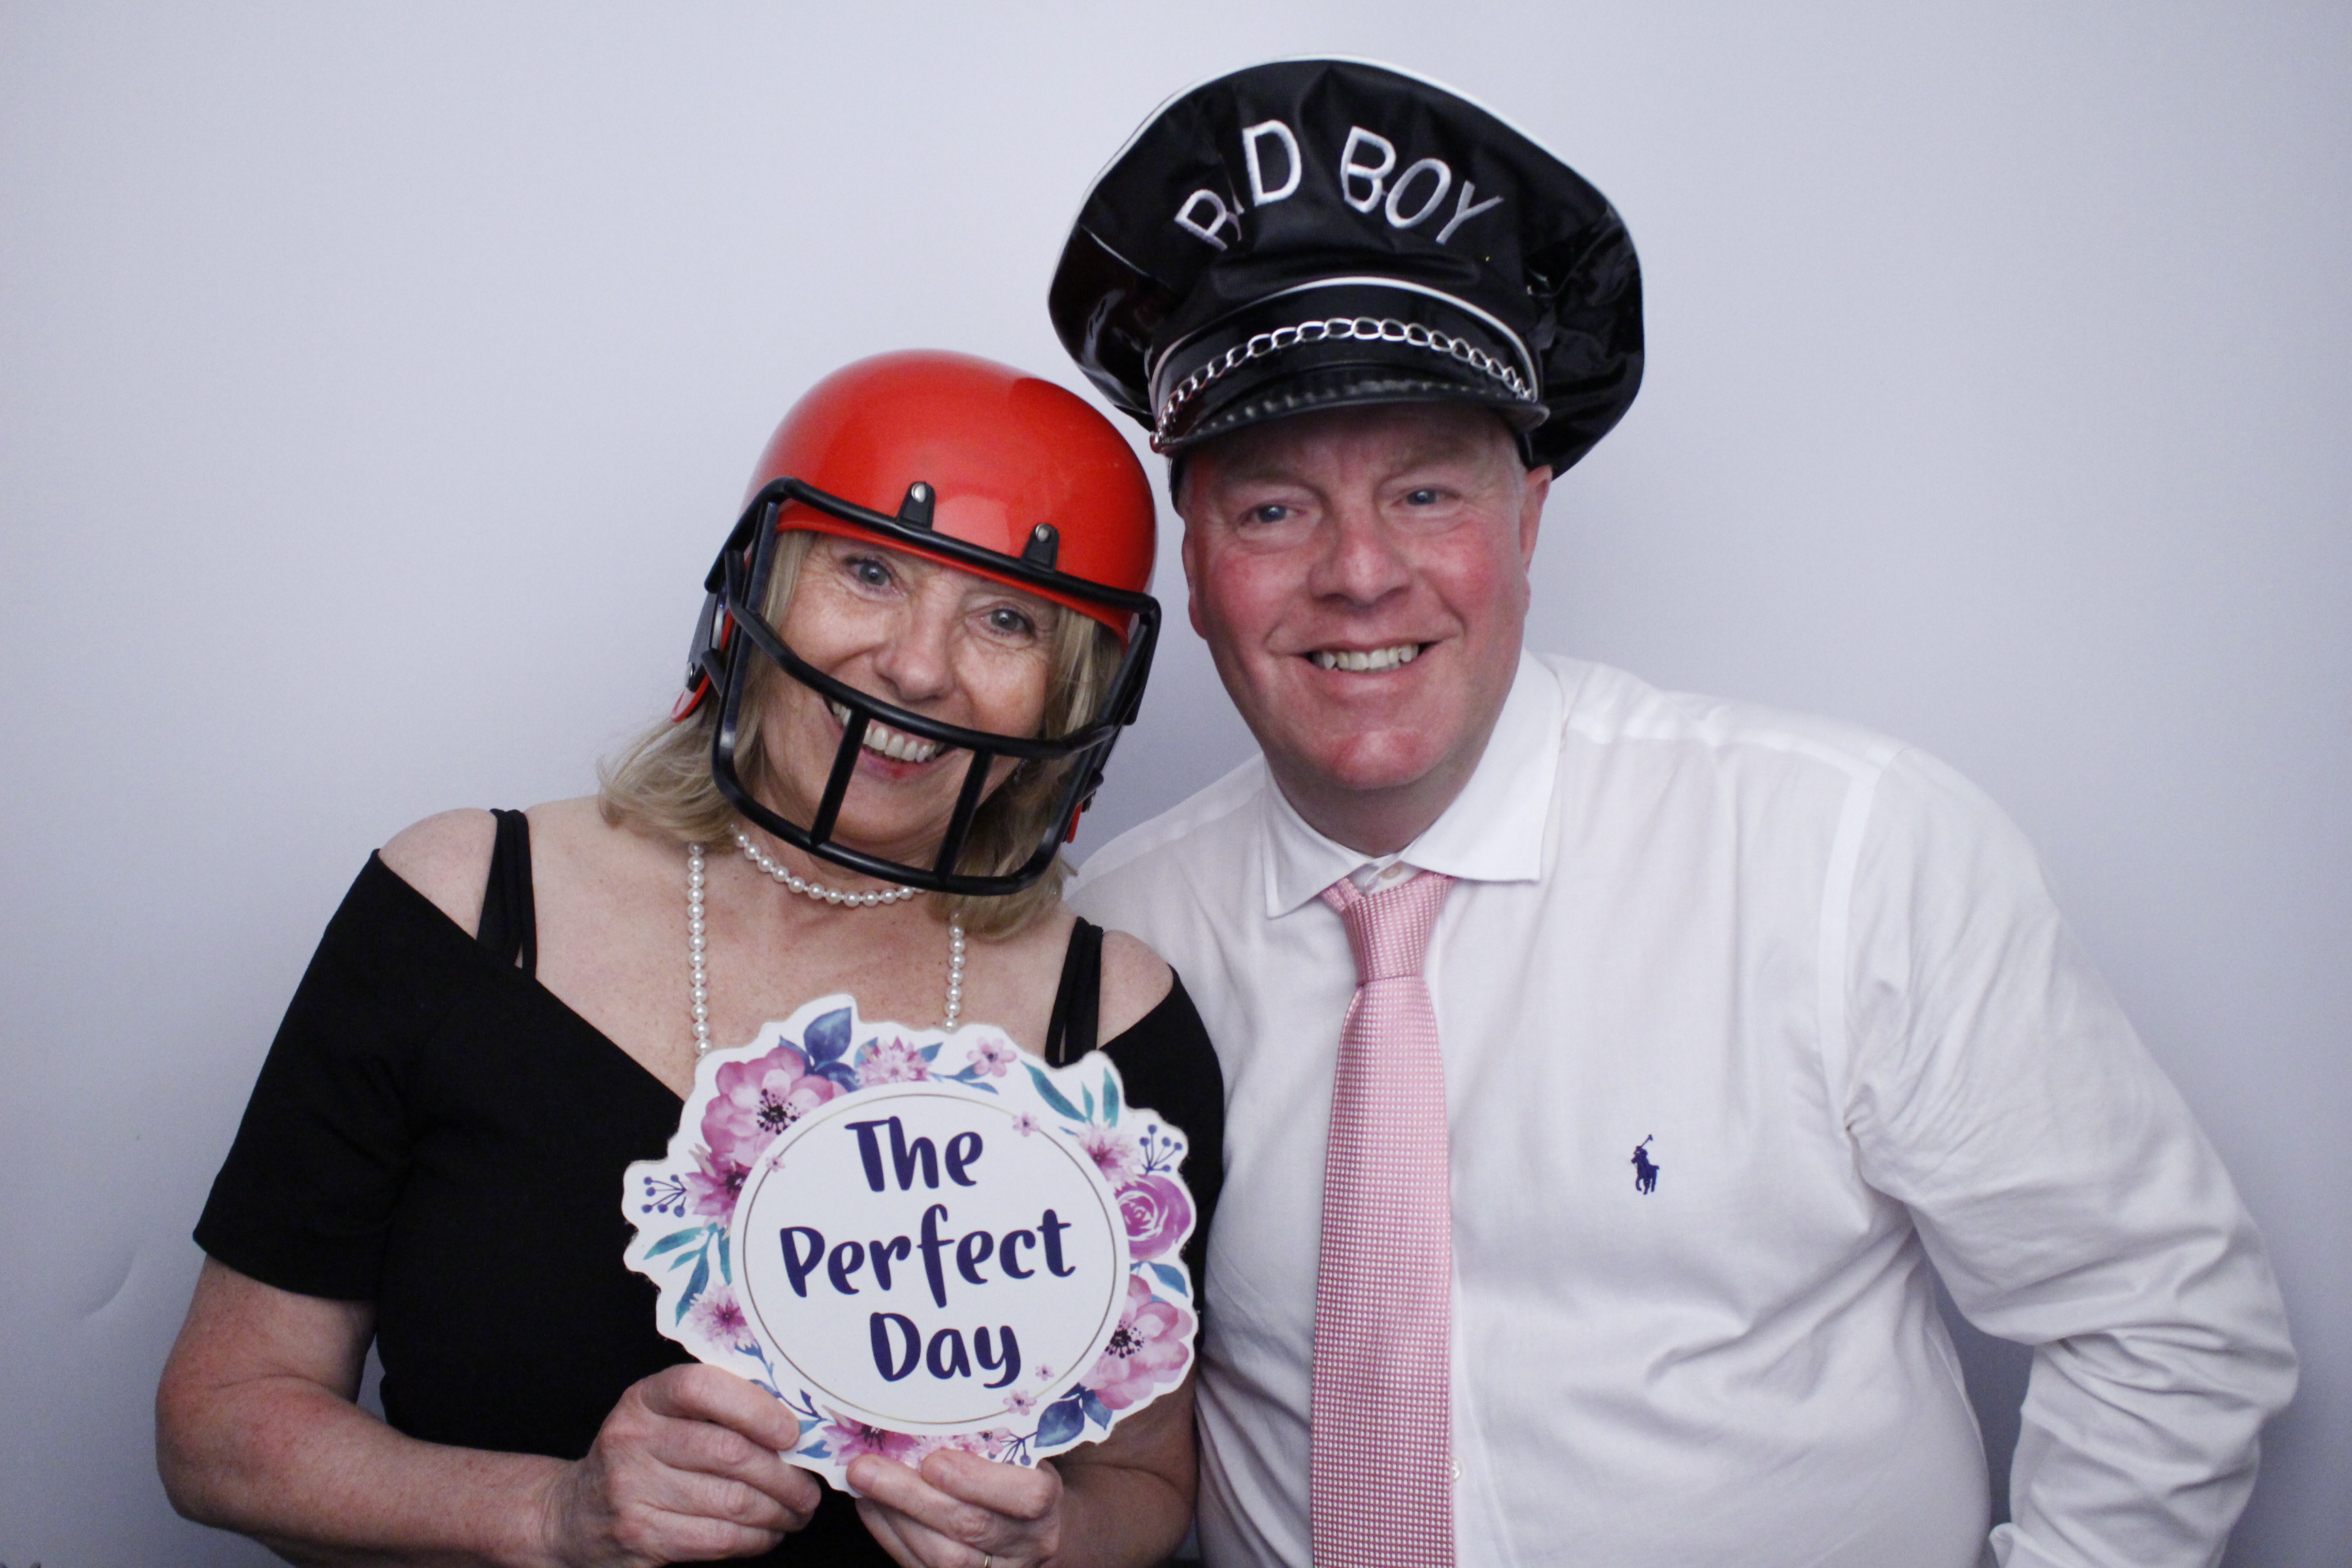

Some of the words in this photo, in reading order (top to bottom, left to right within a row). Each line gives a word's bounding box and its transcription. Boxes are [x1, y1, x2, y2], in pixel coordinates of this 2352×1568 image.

[1174, 119, 1302, 252] BD
[1340, 125, 1505, 246] BOY
[844, 1115, 983, 1192] The
[779, 1203, 1076, 1309] Perfect
[869, 1311, 1022, 1389] Day
